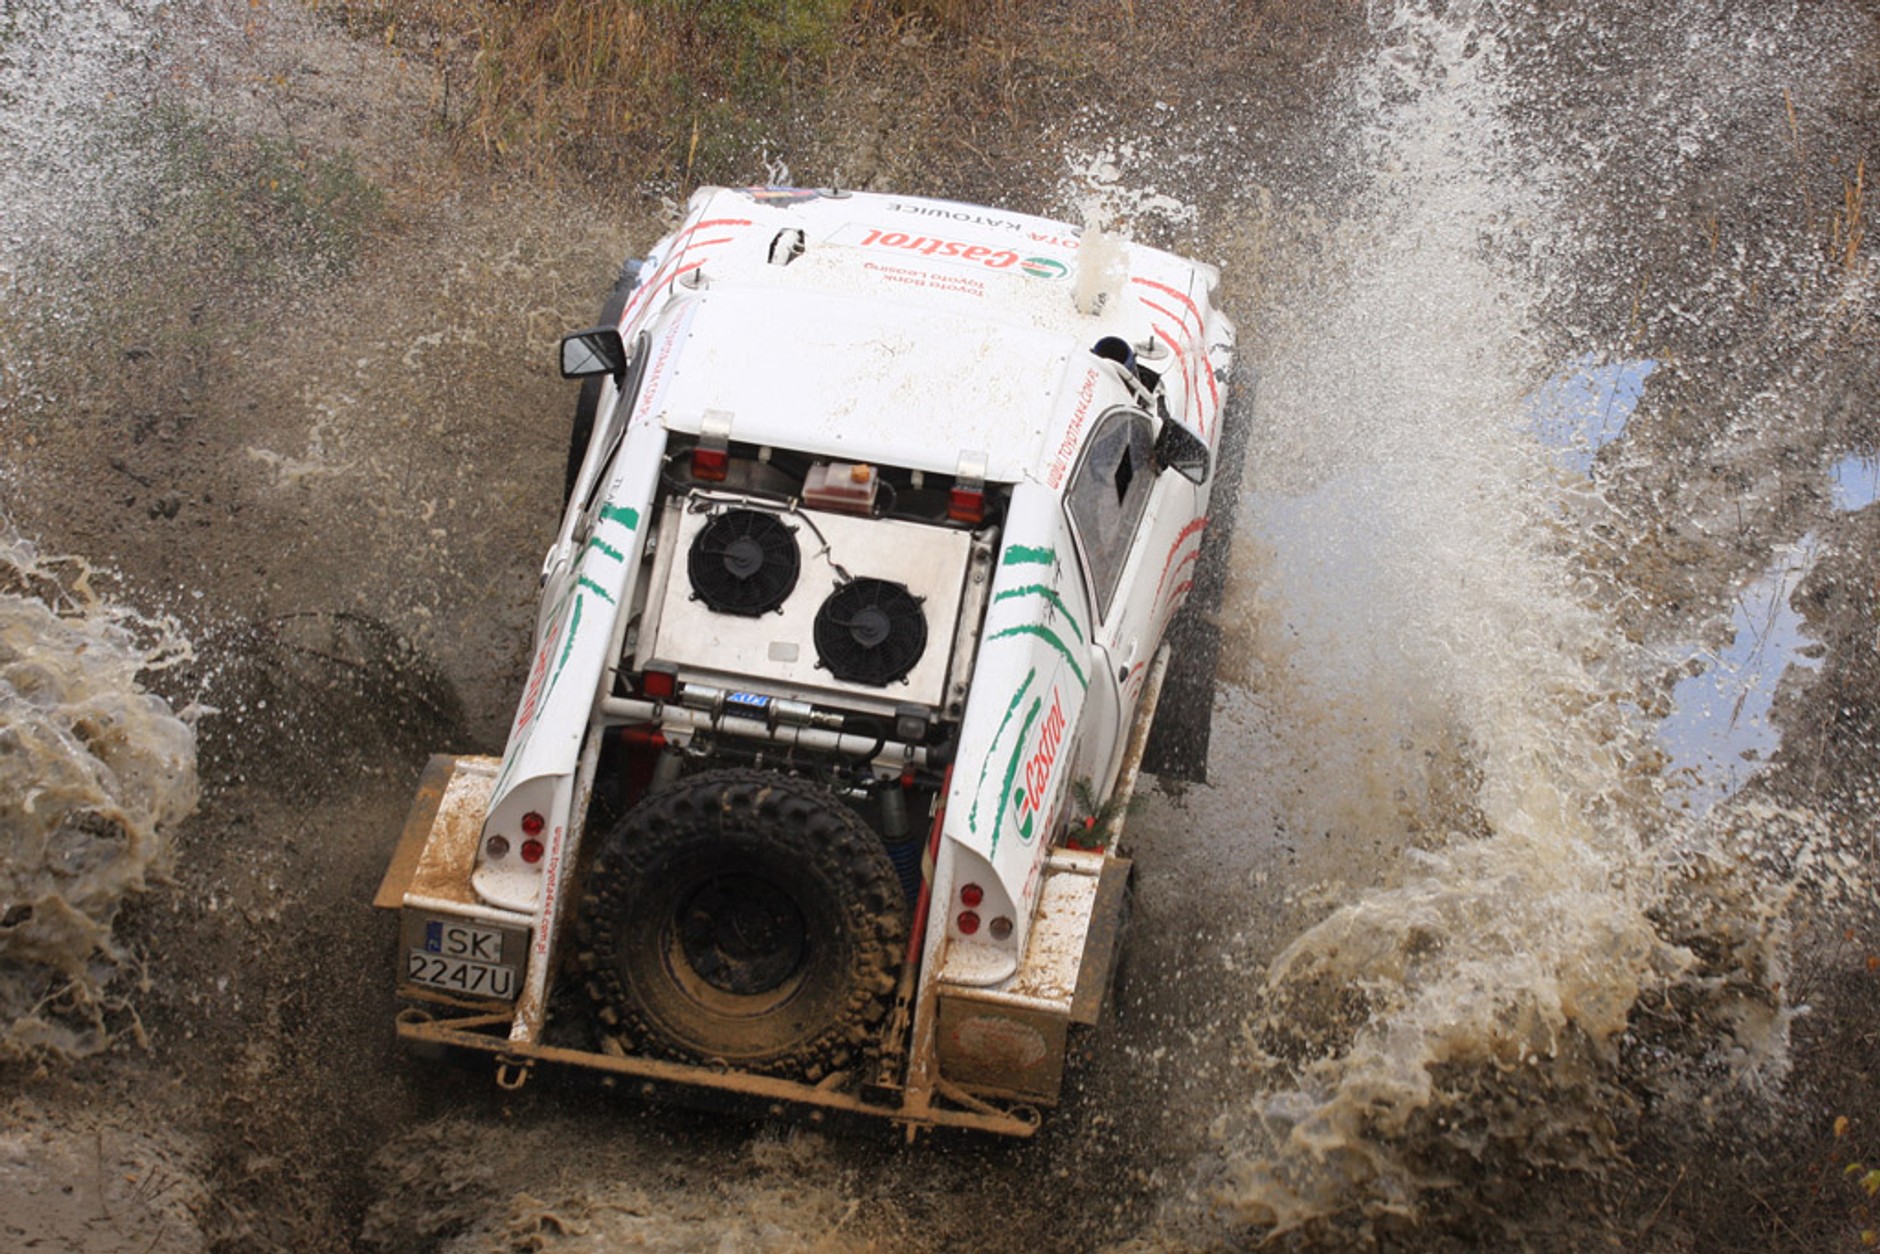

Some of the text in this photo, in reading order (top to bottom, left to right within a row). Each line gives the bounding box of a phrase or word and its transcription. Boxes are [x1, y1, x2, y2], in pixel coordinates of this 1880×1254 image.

[885, 202, 1022, 232] KATOWICE
[859, 228, 1020, 268] Castrol
[863, 262, 986, 289] Toyota Leasing
[883, 274, 985, 297] Toyota Bank
[1025, 684, 1066, 812] Castrol
[447, 928, 493, 960] SK
[409, 955, 510, 995] 2247U
